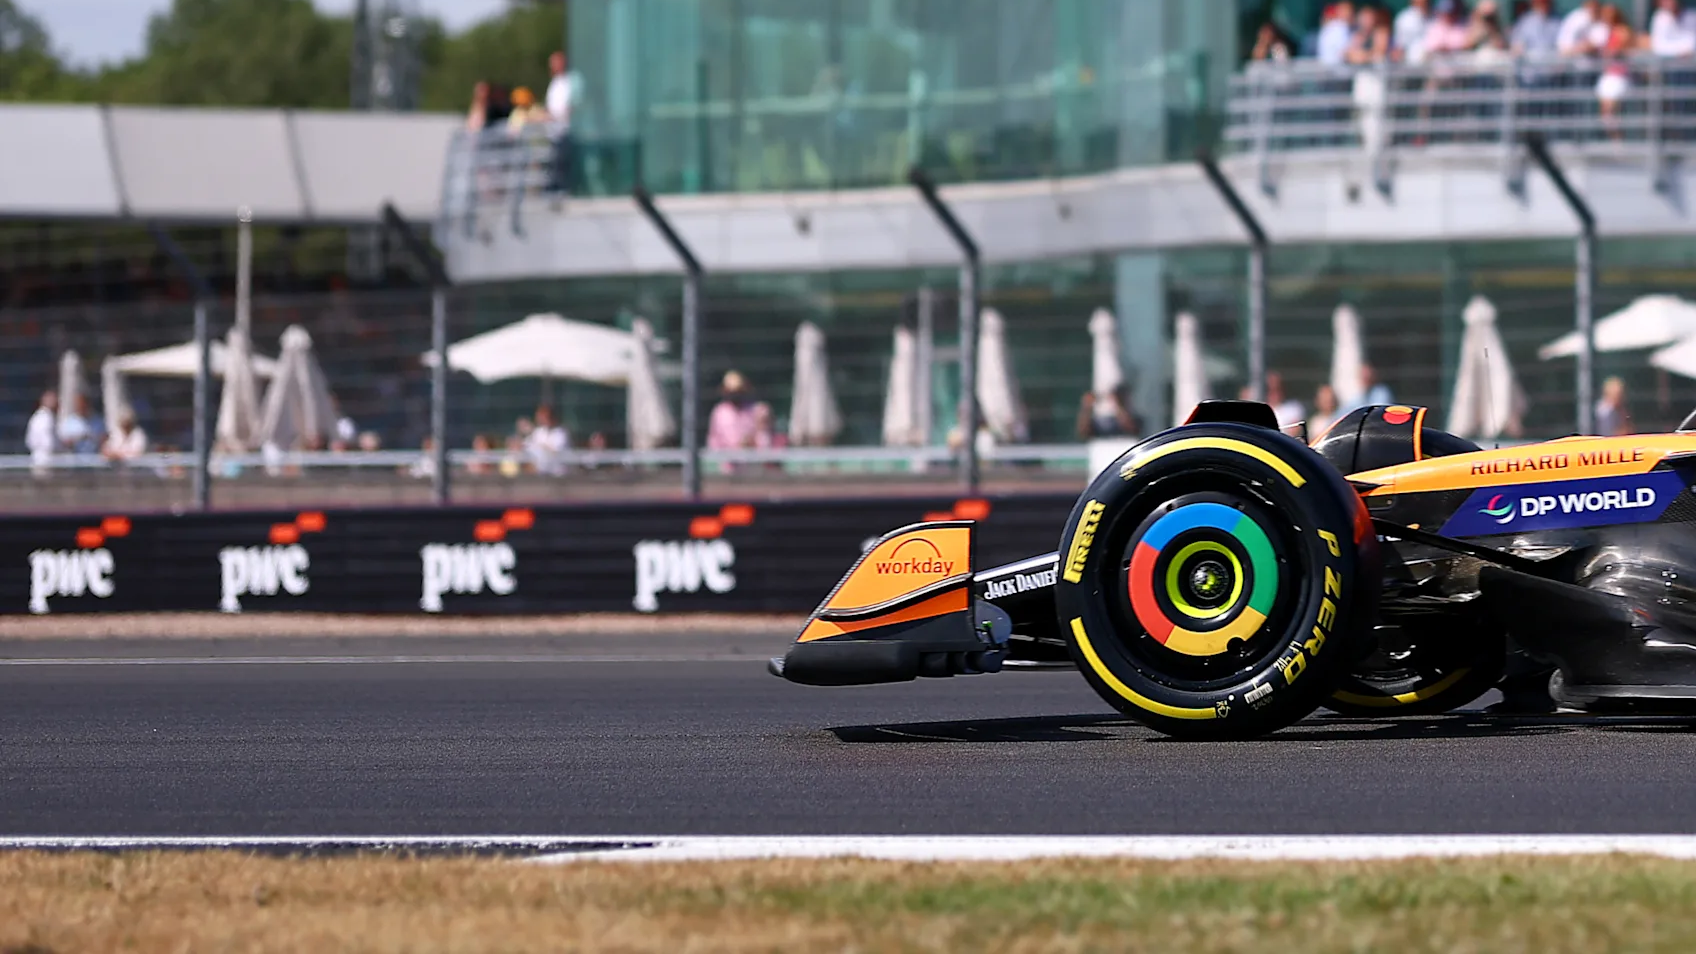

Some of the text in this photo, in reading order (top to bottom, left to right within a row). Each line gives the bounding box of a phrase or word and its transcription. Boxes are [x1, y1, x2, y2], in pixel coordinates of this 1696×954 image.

[1470, 448, 1645, 476] RICHARD MILLE
[1520, 487, 1656, 517] DP WORLD
[633, 540, 736, 612] pwc
[876, 557, 954, 577] workday
[1063, 499, 1106, 584] PIRELLI
[28, 547, 115, 615] pwc
[218, 544, 310, 614] pwc
[420, 542, 517, 613] pwc
[984, 578, 1018, 599] JACK
[1284, 529, 1342, 685] P ZERO
